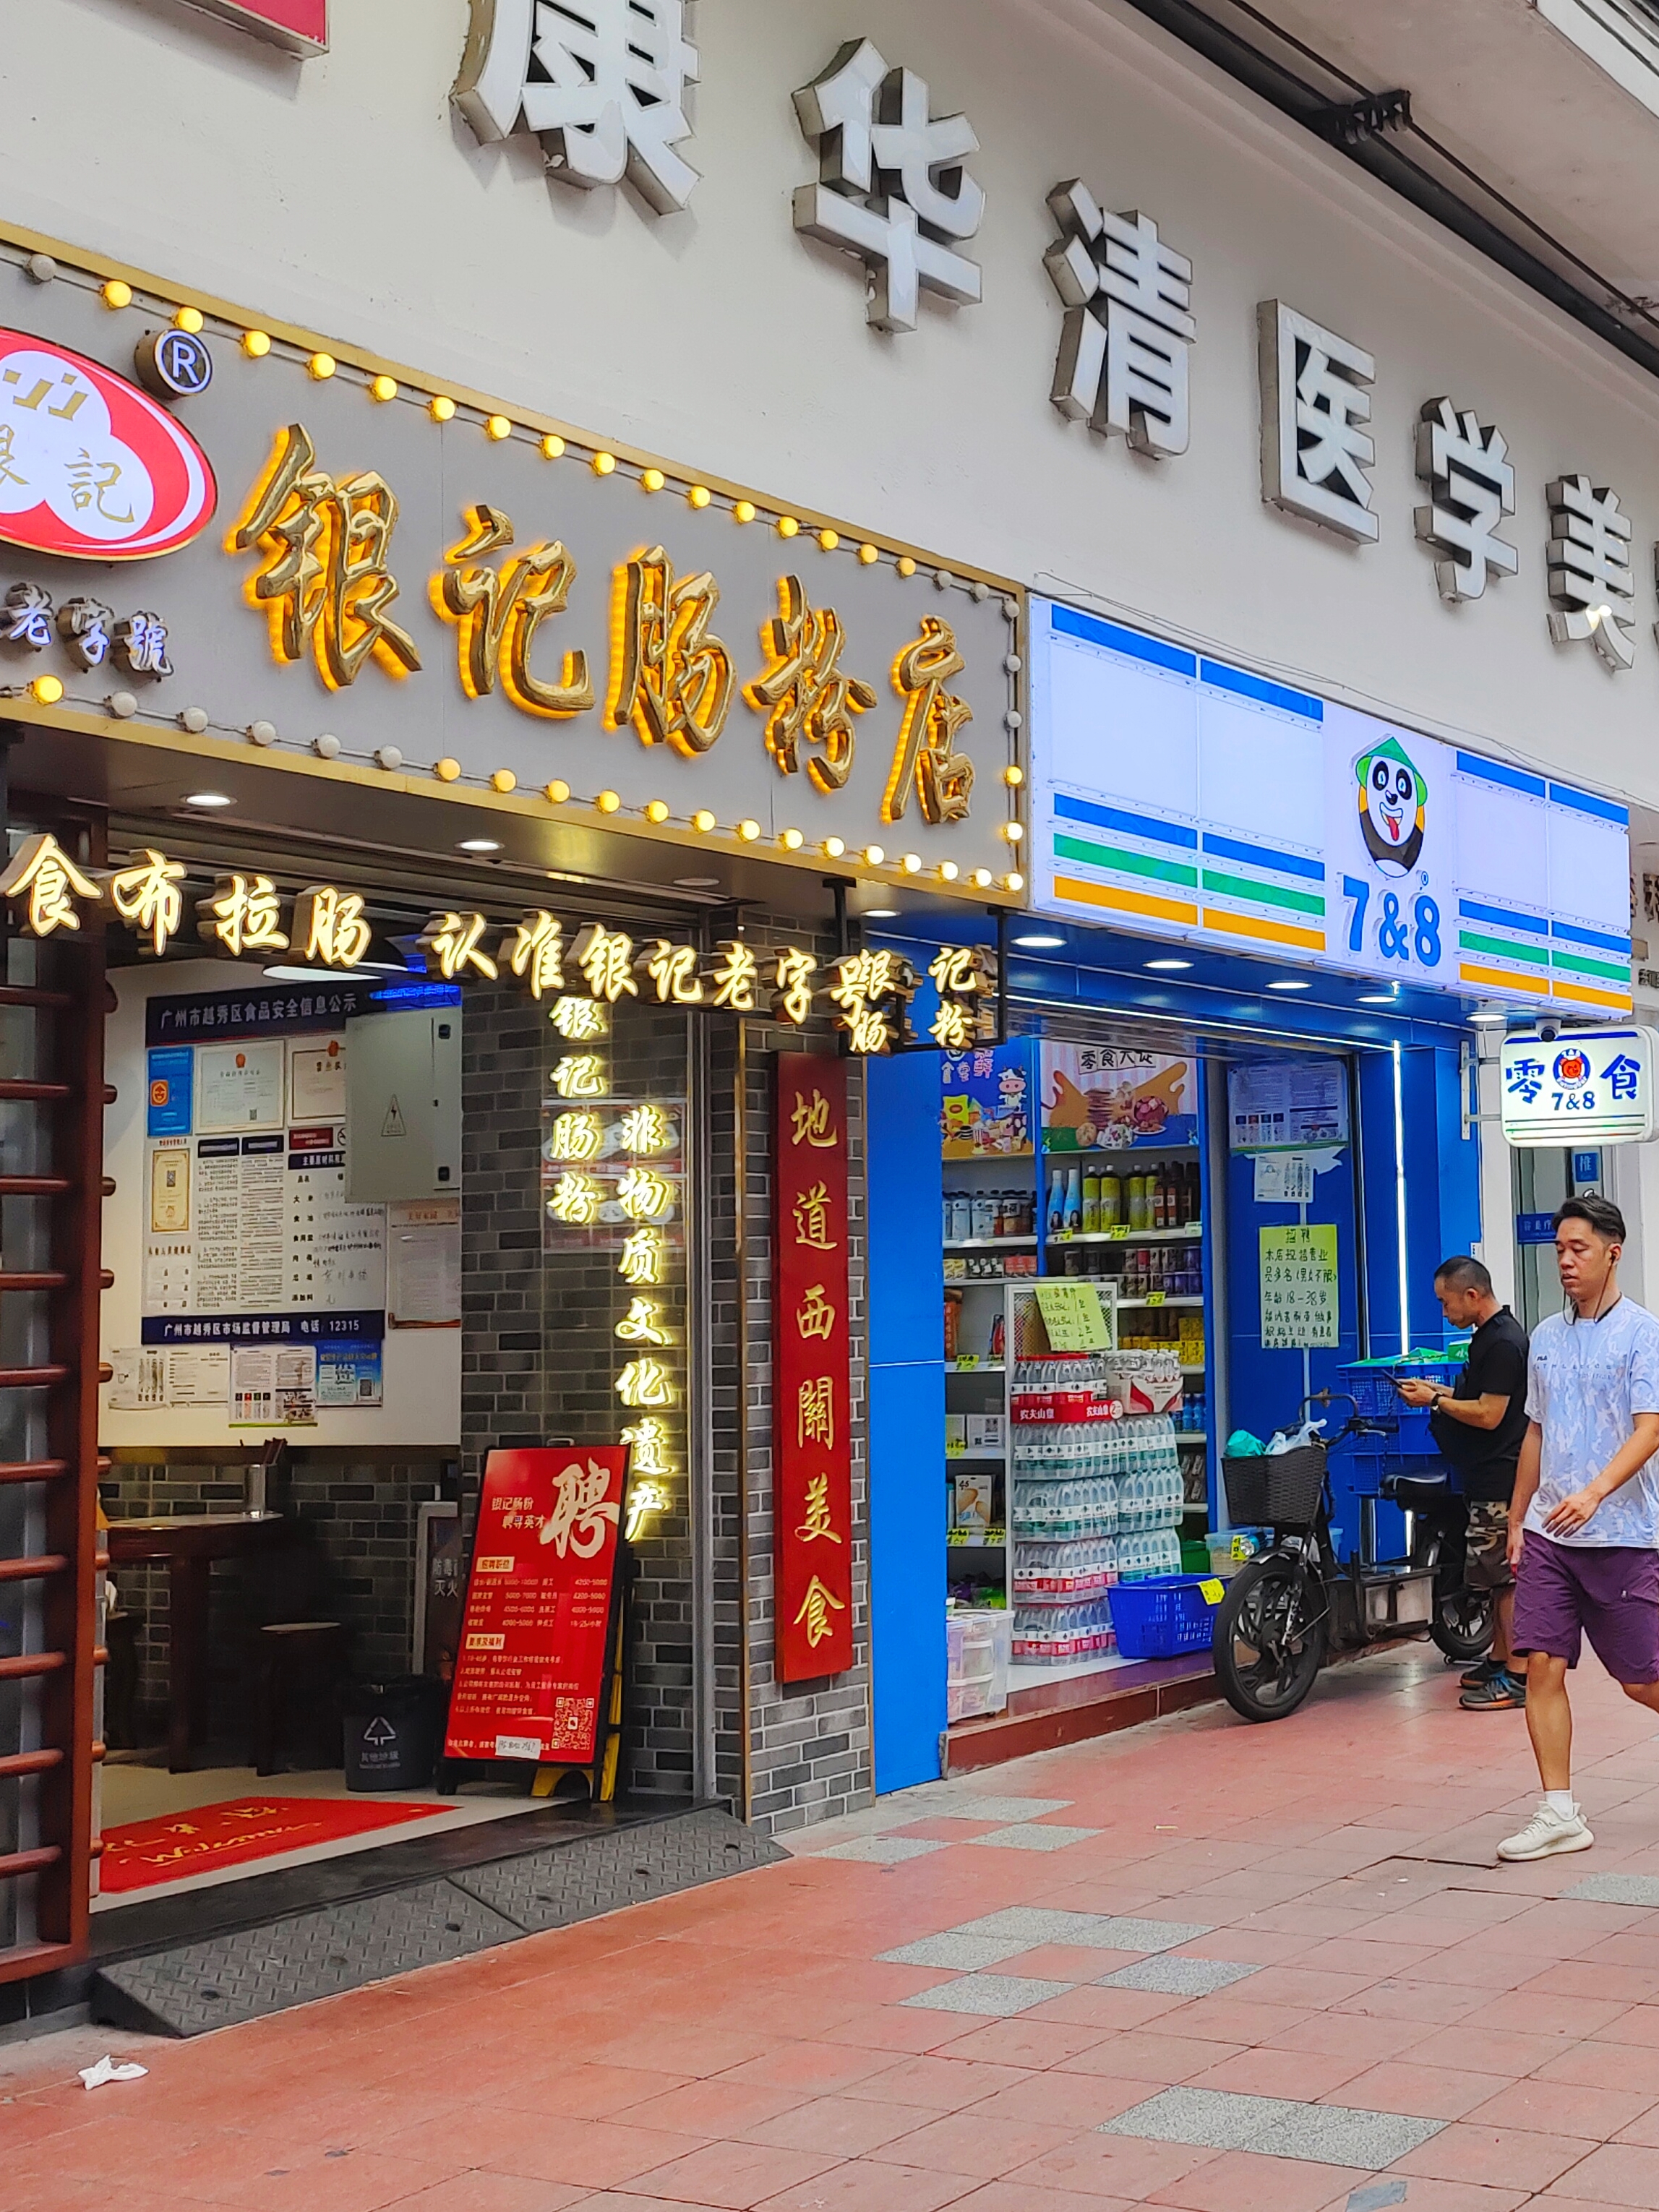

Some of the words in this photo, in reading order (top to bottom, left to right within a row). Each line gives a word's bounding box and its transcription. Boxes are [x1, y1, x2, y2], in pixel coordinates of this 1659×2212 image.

[447, 0, 1659, 671] 康华清医学美
[6, 583, 174, 677] 老字號
[1343, 874, 1441, 967] 7&8
[160, 993, 356, 1029] 广州市越秀区食品安全信息公示
[849, 1000, 973, 1053] 肠粉
[546, 996, 608, 1223] 银记肠粉
[1551, 1091, 1595, 1111] 7&8
[164, 1321, 290, 1337] 广州市越秀区市场监督管理局
[300, 1320, 320, 1333] 电话
[330, 1319, 360, 1332] 12315
[615, 1105, 674, 1542] 非物质文化遗产
[790, 1090, 846, 1649] 地道西關美食
[540, 1457, 620, 1559] 聘
